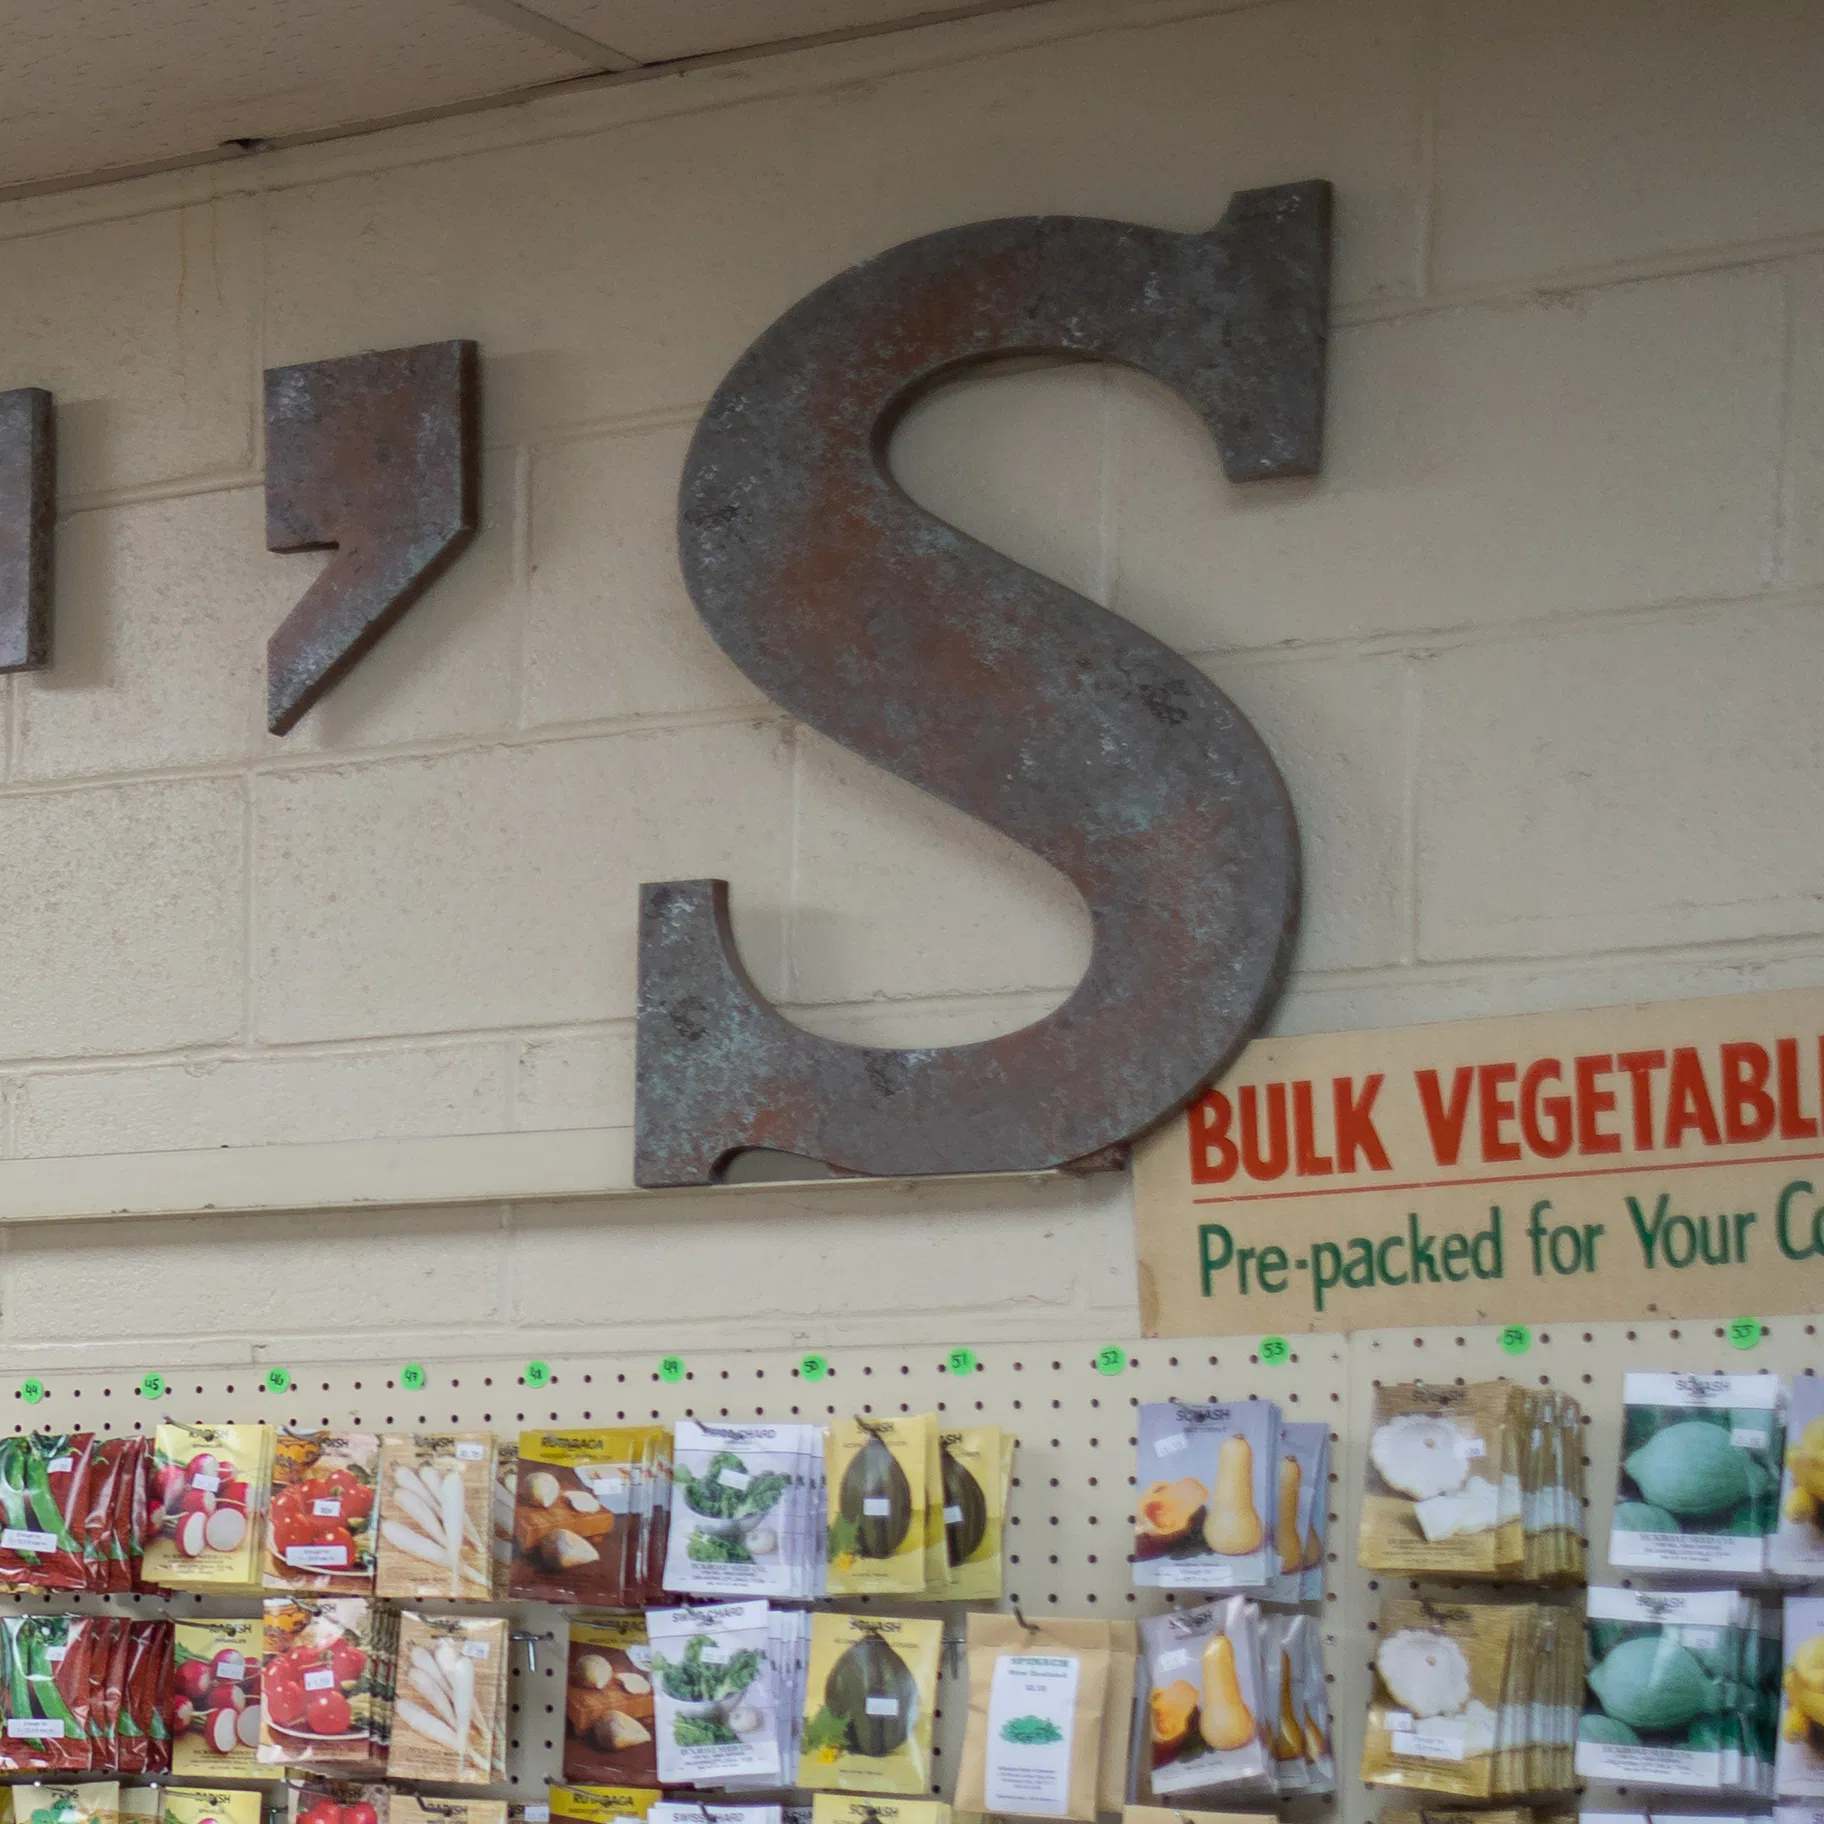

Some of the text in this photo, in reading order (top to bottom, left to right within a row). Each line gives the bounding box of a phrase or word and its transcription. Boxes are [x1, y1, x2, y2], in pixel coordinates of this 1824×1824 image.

[1188, 1036, 1824, 1185] BULK VEGETABL
[1199, 1193, 1758, 1312] Pre-packed for Your
